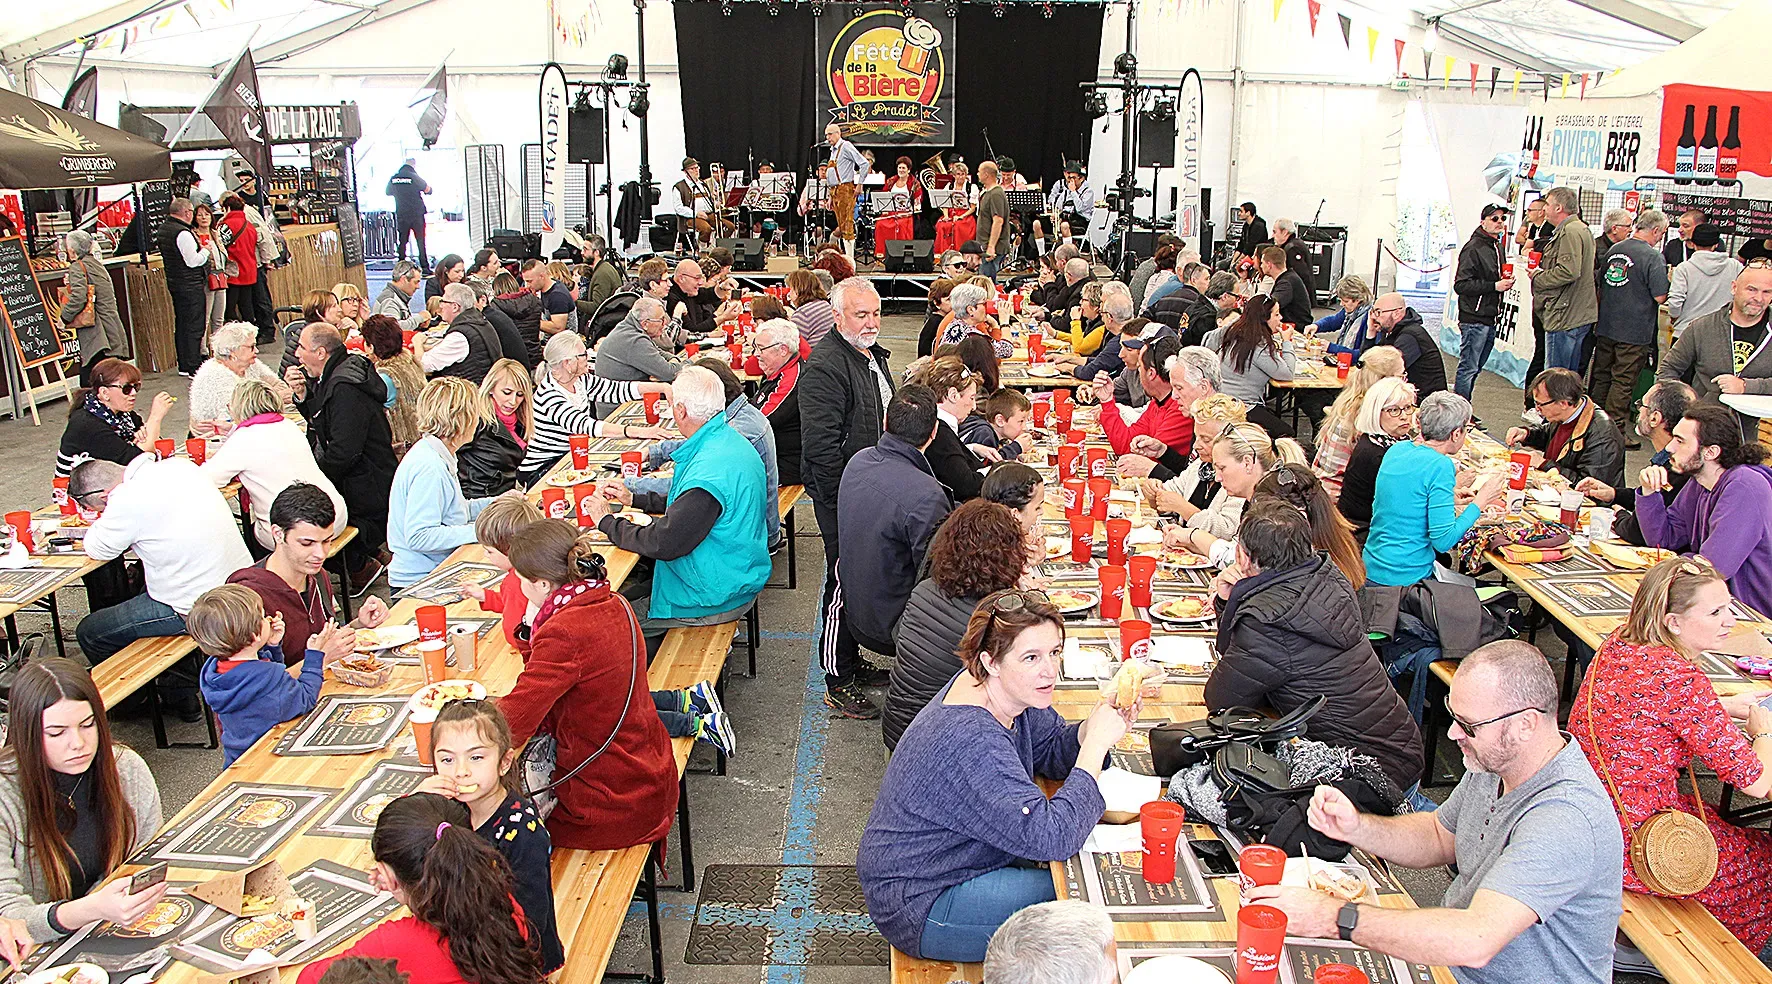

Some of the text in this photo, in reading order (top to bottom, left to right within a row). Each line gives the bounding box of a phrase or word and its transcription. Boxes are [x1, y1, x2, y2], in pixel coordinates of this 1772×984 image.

[853, 43, 902, 61] Fête
[847, 62, 877, 73] de la
[853, 73, 920, 97] Bière
[851, 102, 918, 120] Le Pradet
[269, 106, 288, 139] DE
[290, 107, 308, 139] LA
[310, 106, 342, 139] RADE
[1598, 115, 1608, 127] DE
[1550, 129, 1602, 169] RIVIERA
[62, 156, 115, 171] GRIMBERGEN
